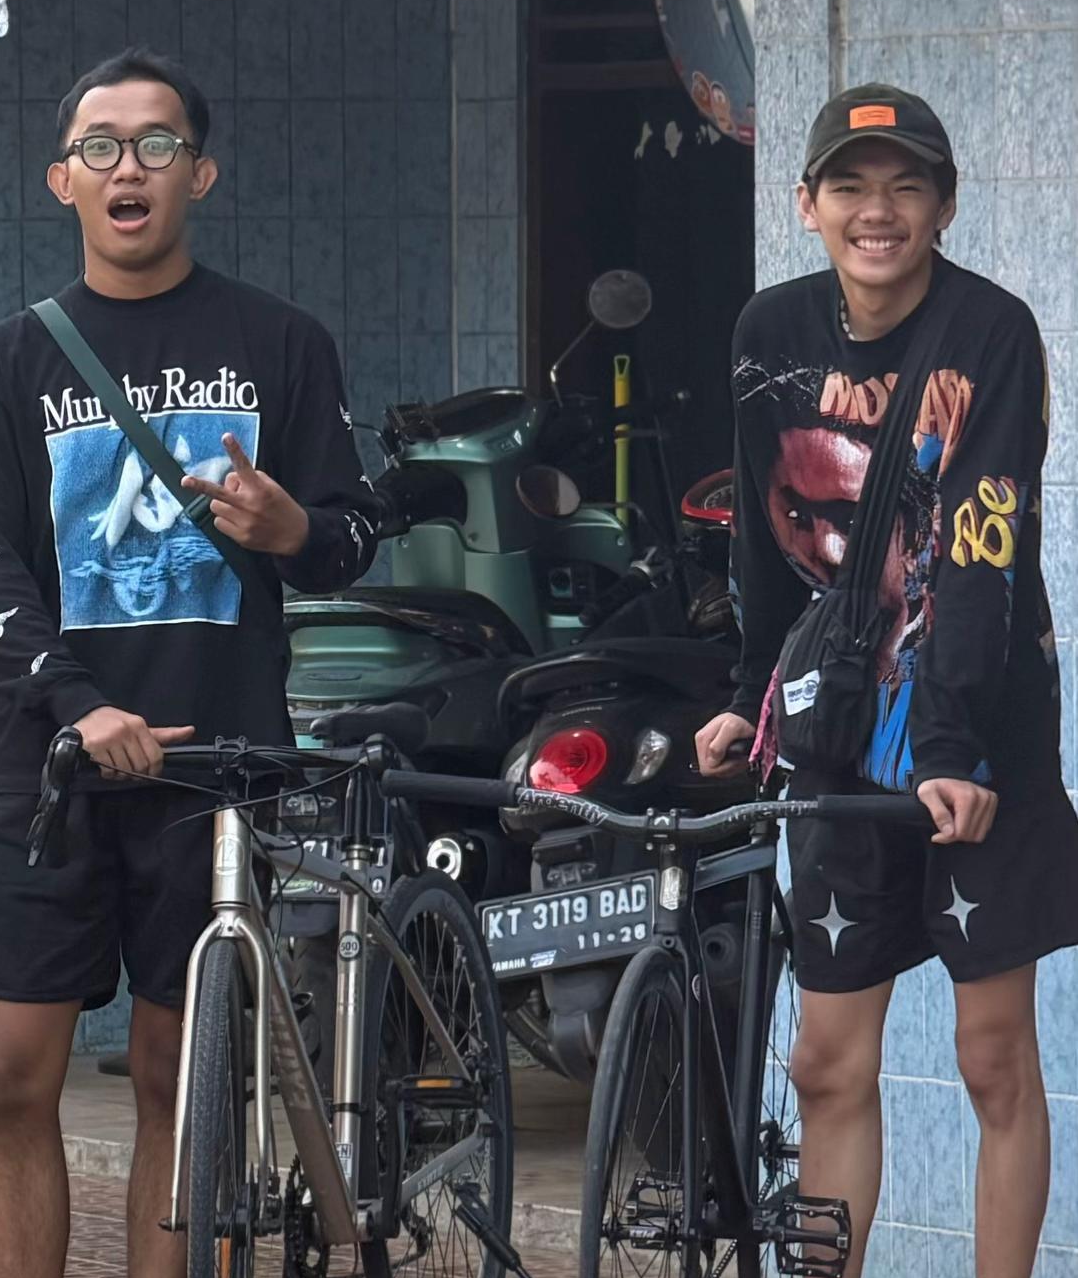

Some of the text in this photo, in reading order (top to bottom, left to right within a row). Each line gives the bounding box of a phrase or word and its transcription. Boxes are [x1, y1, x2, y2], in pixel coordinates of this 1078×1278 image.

[161, 366, 259, 411] Radio
[488, 883, 648, 940] KT 3119 BAD
